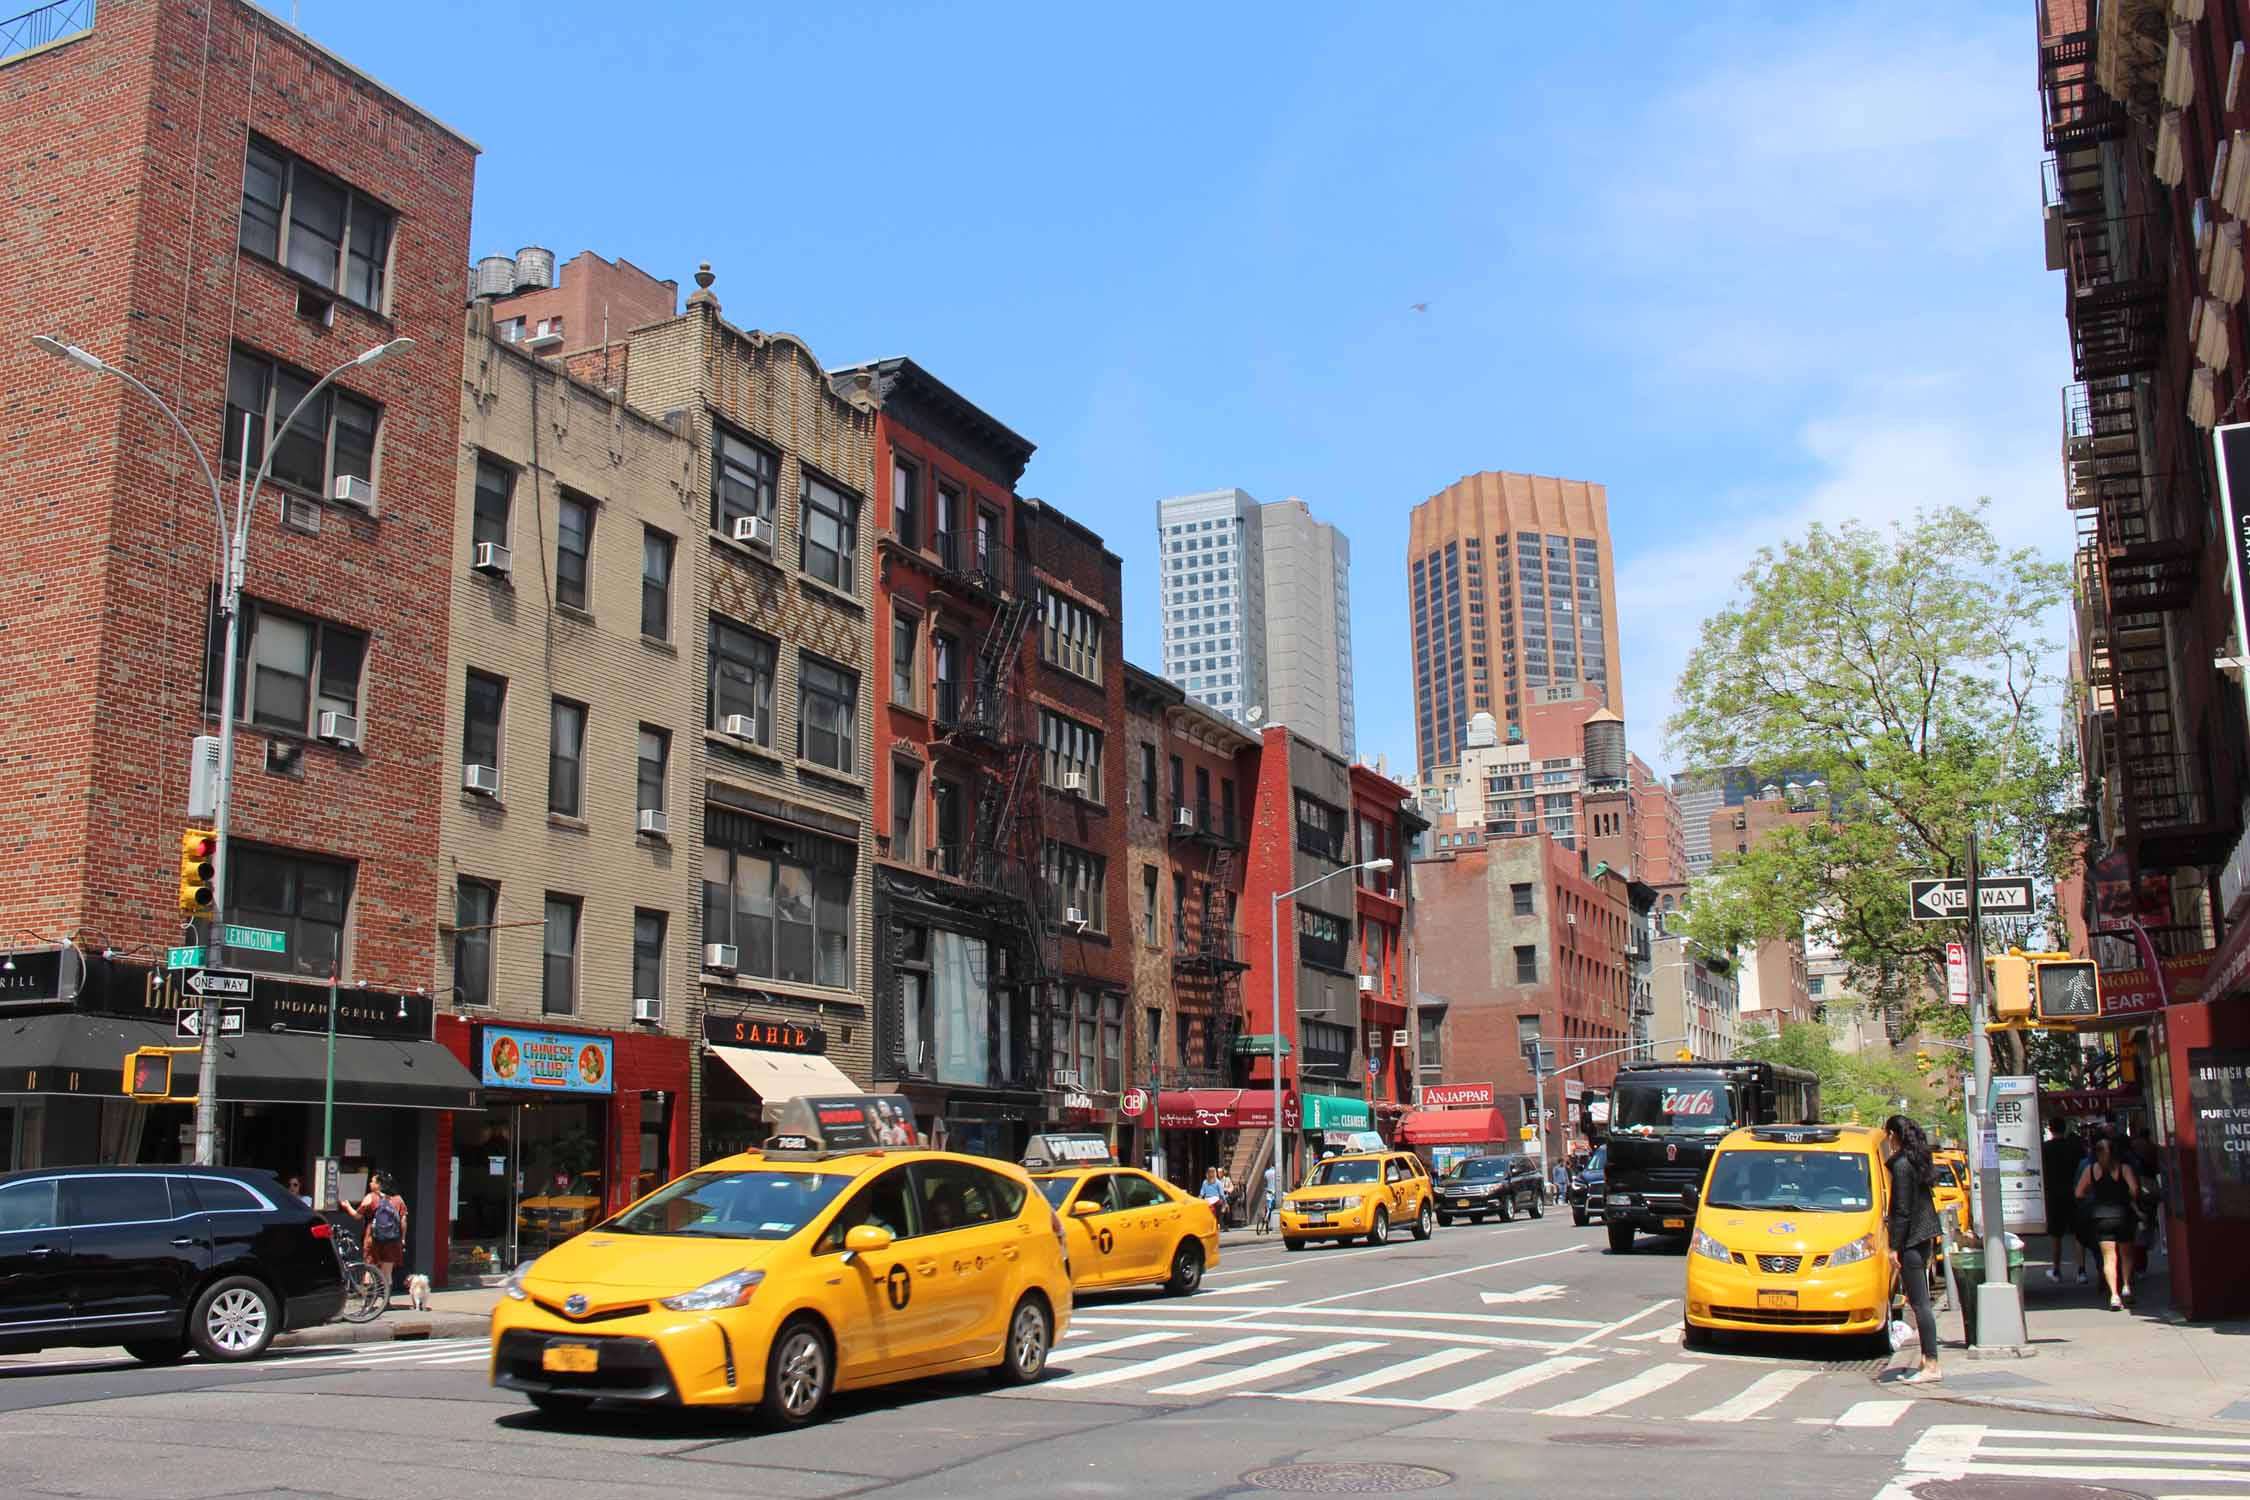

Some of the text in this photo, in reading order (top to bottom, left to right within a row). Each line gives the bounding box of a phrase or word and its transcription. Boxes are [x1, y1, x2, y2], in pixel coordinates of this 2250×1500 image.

[1931, 890, 2017, 906] ONE WAY
[225, 927, 273, 948] LEXINGTON
[170, 949, 195, 966] E 27
[195, 976, 245, 990] ONE WAY
[274, 1000, 385, 1021] INDIAN GRILL
[736, 1023, 808, 1047] SAHIB
[523, 1042, 575, 1062] CHINESE
[534, 1060, 565, 1078] CLUB
[1426, 1089, 1489, 1104] ANJAPPAR
[1341, 1115, 1367, 1128] CLEANERS
[2201, 1109, 2231, 1118] PURE
[1784, 1132, 1803, 1143] 1G27
